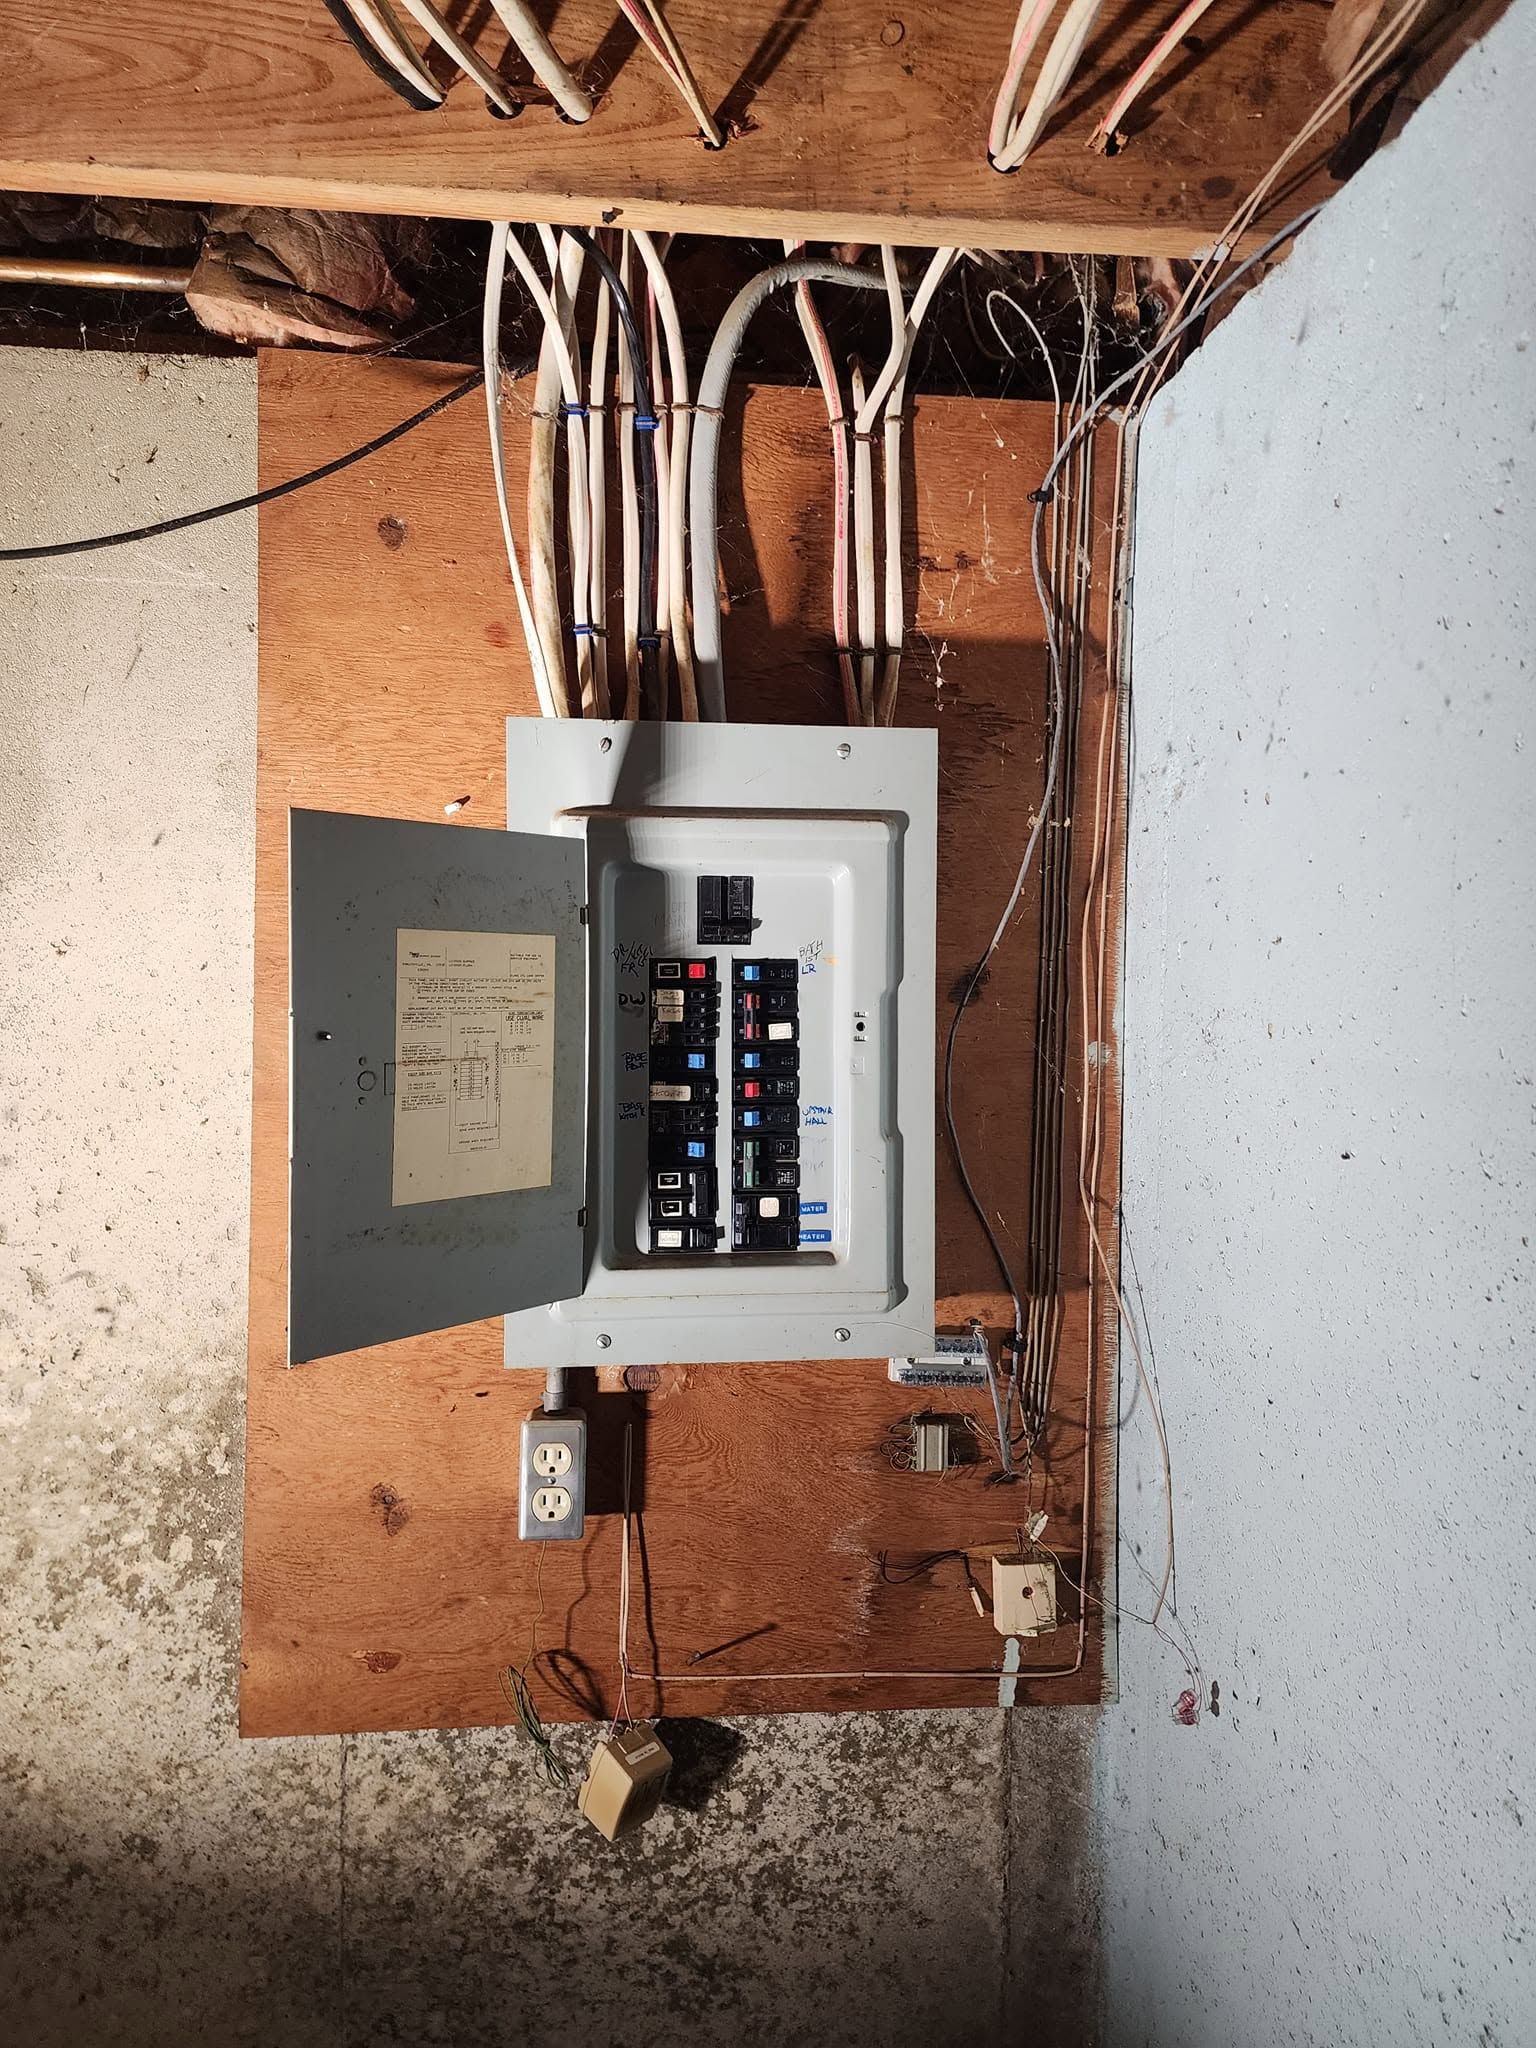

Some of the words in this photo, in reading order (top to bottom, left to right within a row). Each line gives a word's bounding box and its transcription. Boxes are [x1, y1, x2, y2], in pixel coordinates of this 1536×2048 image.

[801, 963, 816, 974] LR
[618, 991, 646, 1005] DW
[805, 1117, 828, 1126] HALL
[801, 1205, 825, 1213] WATER
